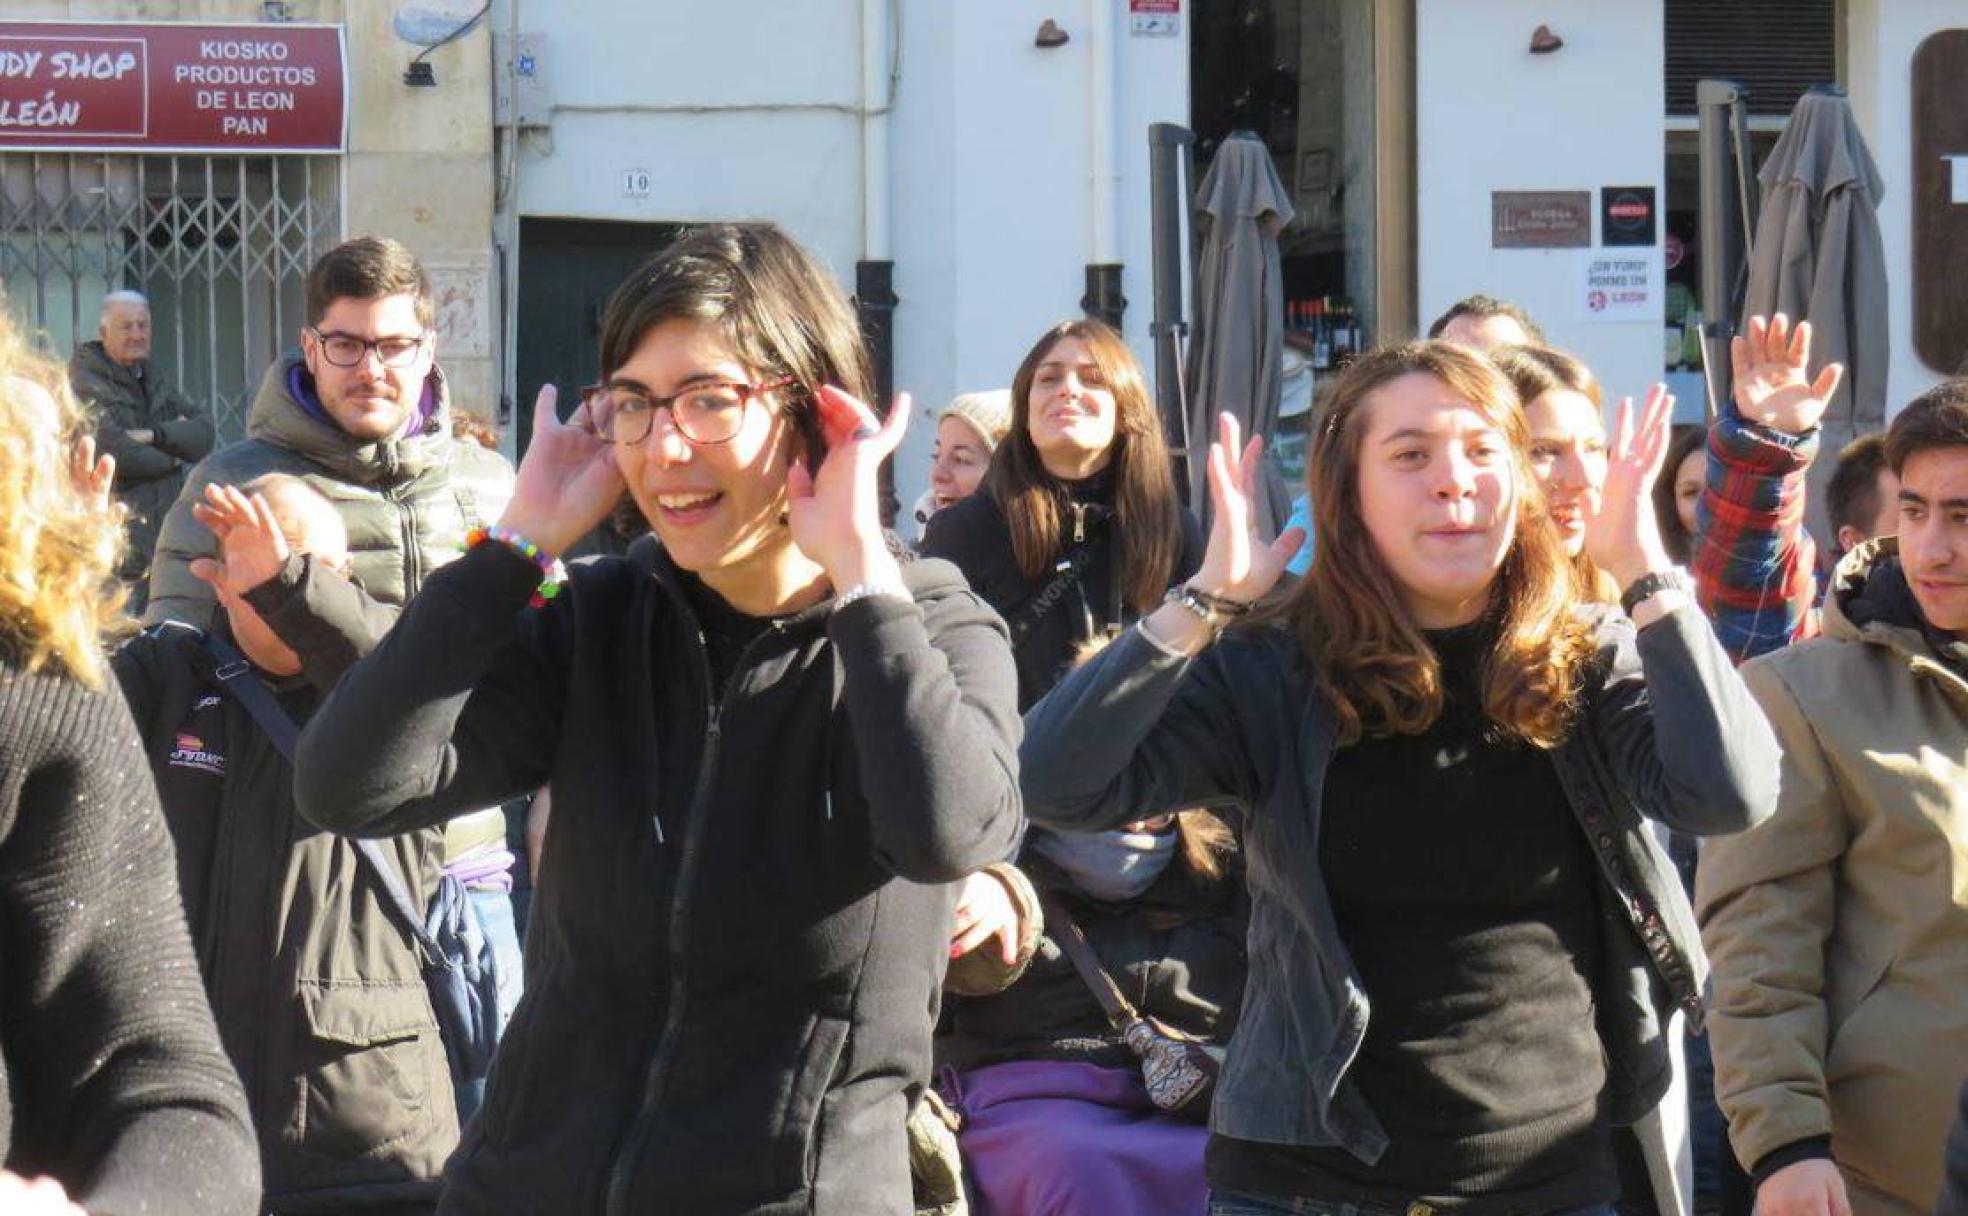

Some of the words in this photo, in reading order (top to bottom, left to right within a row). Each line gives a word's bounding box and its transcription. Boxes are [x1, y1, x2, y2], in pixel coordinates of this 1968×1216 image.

[200, 41, 288, 60] KIOSKO
[50, 51, 136, 80] SHOP
[175, 65, 316, 85] PRODUCTOS
[0, 89, 81, 126] LEÓN
[197, 91, 227, 109] DE
[234, 91, 295, 110] LEON
[222, 116, 268, 135] PAN
[627, 174, 649, 190] 10
